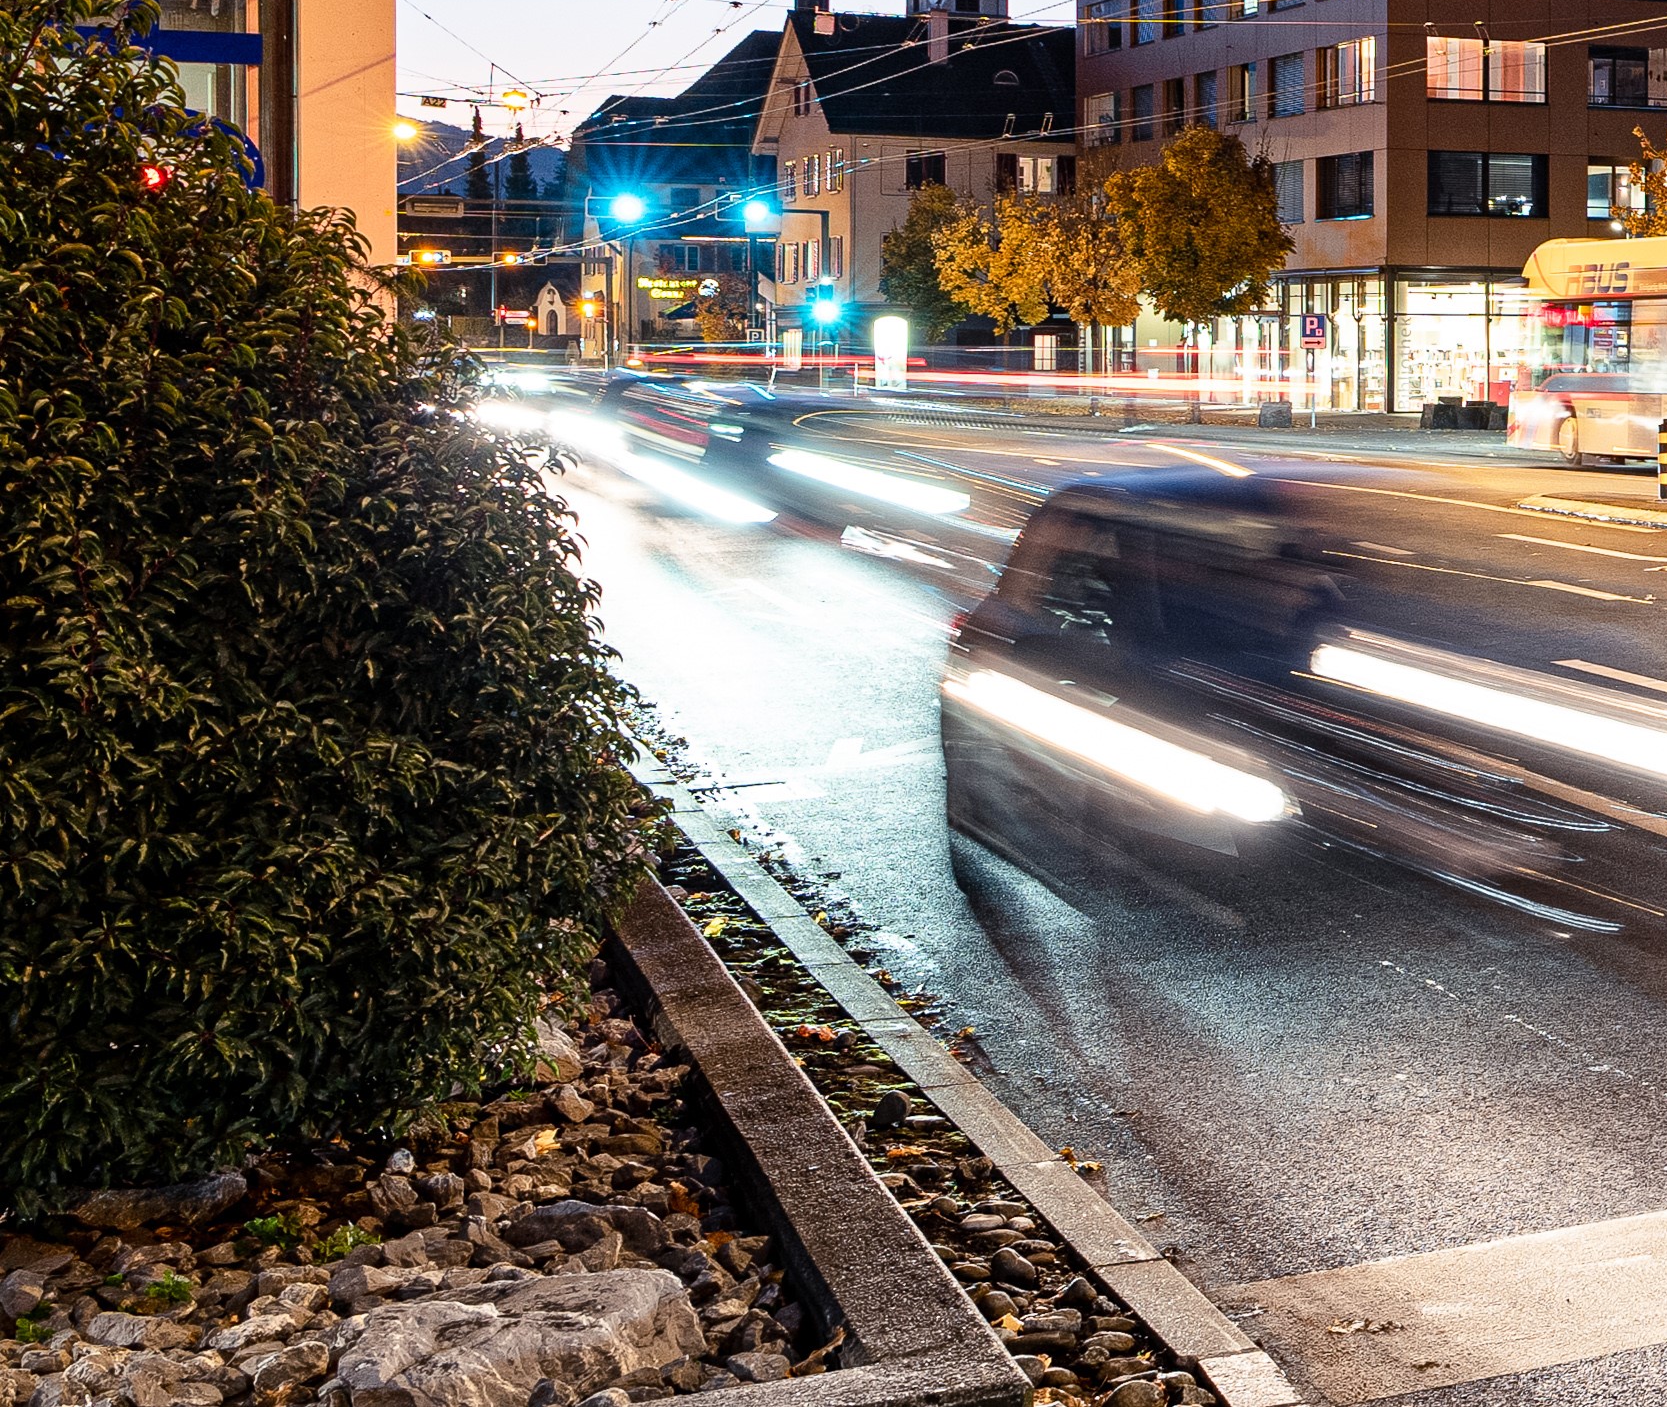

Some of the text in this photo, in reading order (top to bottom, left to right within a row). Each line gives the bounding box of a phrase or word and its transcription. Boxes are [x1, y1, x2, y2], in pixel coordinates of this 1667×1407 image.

[422, 97, 446, 108] A22
[1305, 317, 1318, 335] P
[752, 332, 760, 342] P
